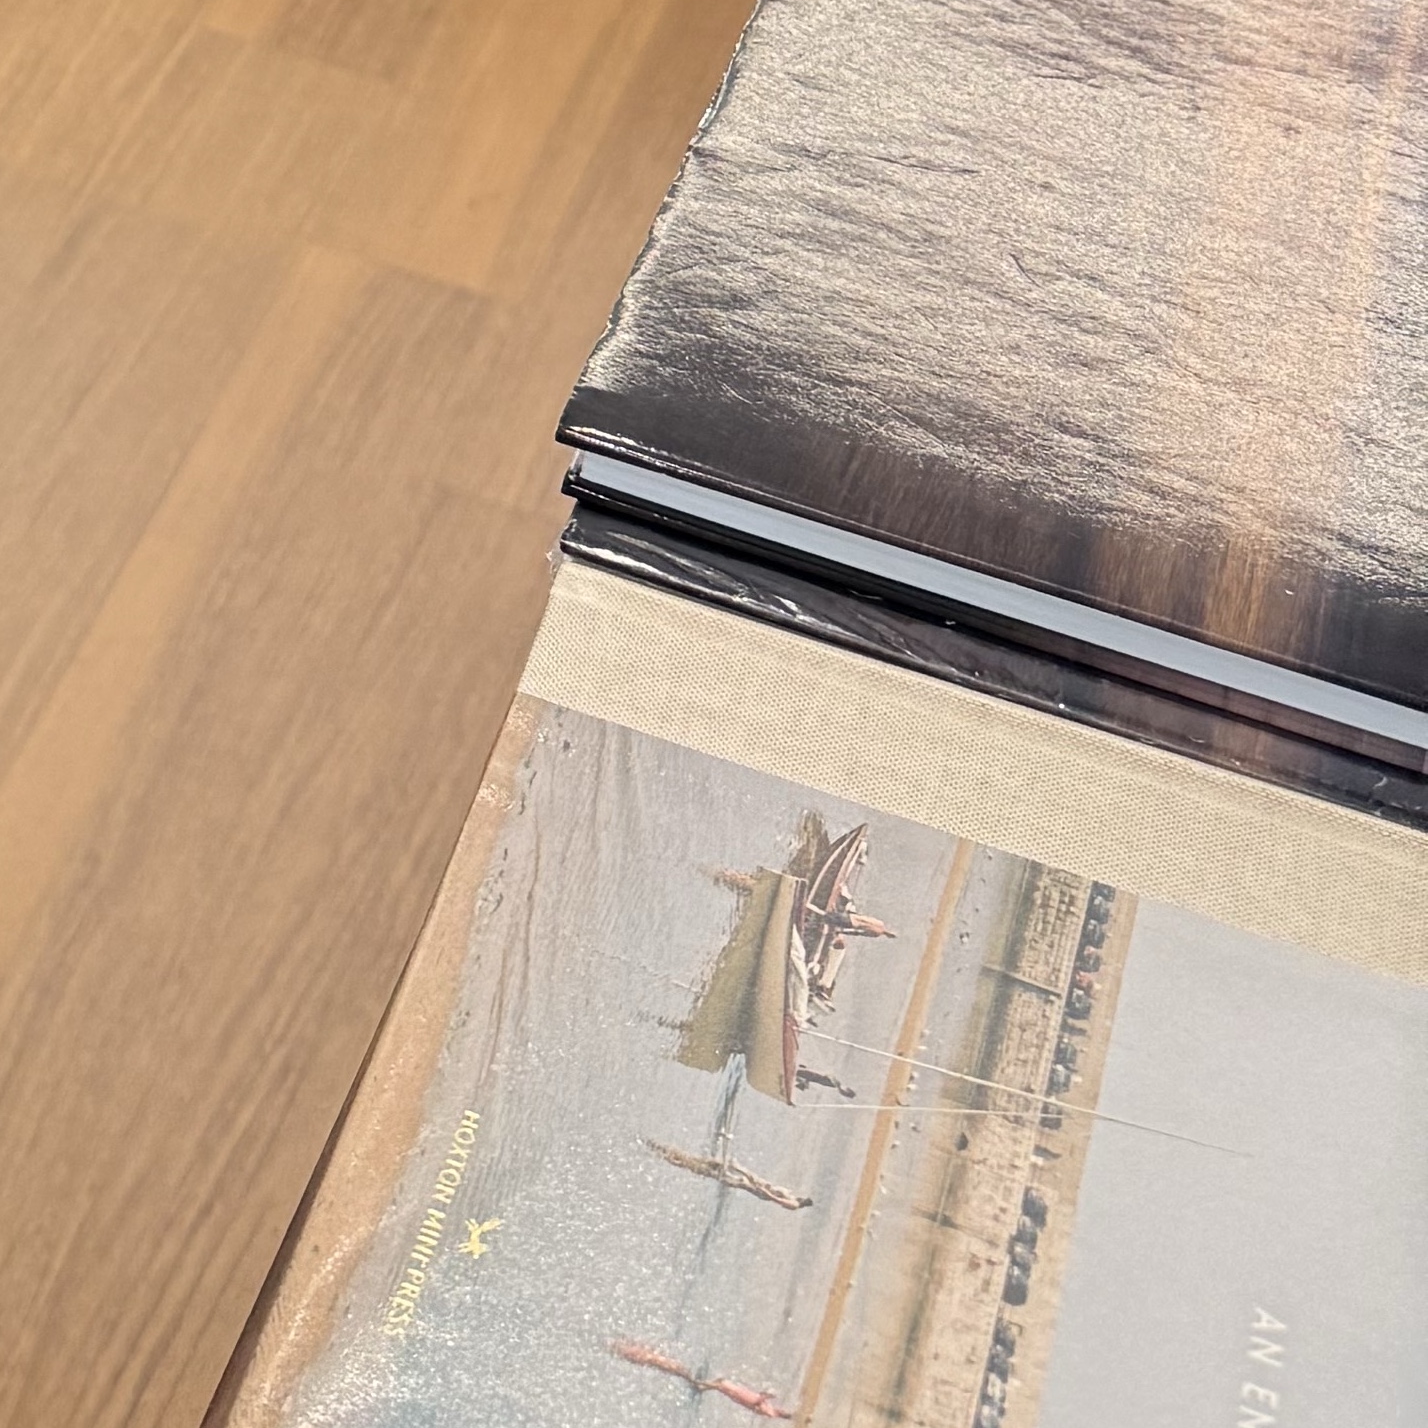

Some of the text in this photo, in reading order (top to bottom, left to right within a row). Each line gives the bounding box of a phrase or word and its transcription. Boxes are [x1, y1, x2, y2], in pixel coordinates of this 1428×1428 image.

[431, 1108, 481, 1205] HOXTON
[384, 1267, 426, 1338] PRESS
[1246, 1306, 1288, 1369] AN
